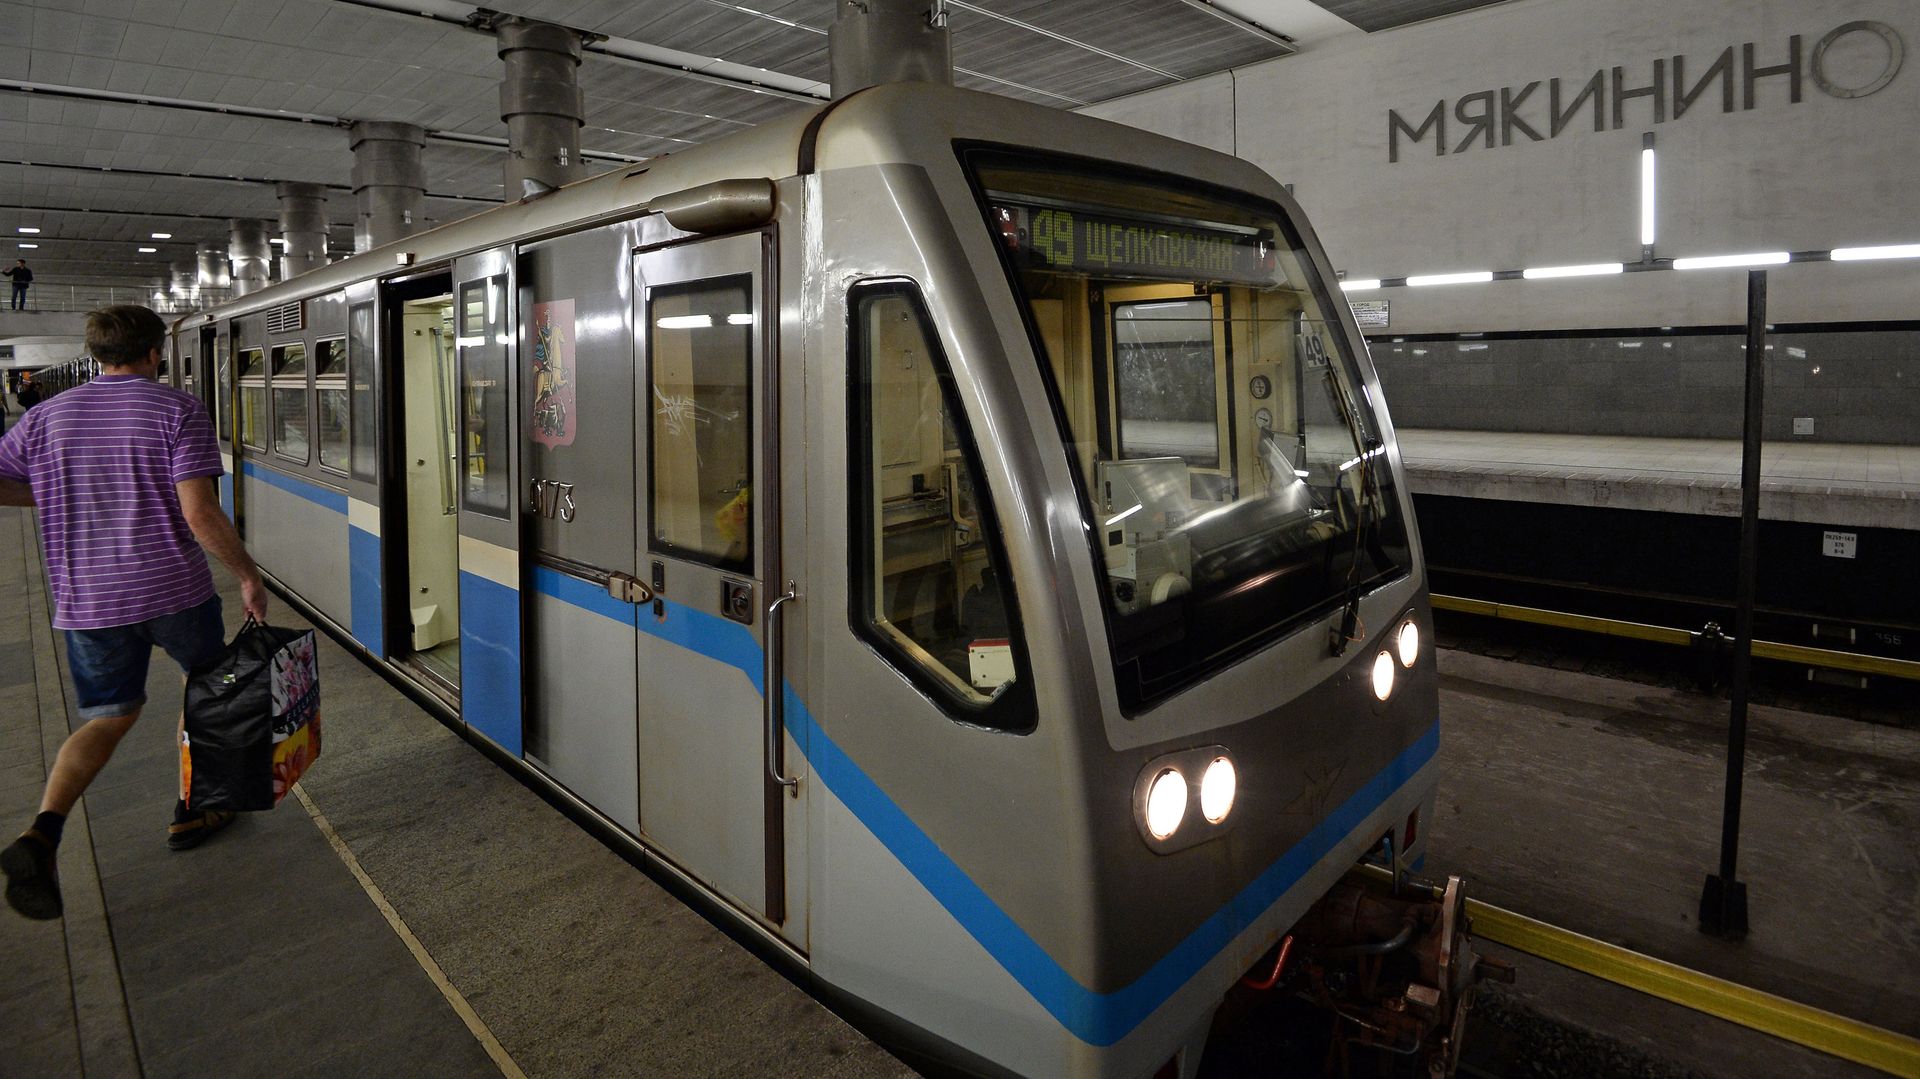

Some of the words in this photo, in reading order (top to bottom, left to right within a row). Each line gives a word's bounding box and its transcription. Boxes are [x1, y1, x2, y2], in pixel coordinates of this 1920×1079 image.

[1388, 20, 1905, 162] МЯКИНИНО
[1032, 209, 1074, 265] 49
[1305, 335, 1325, 366] 49
[529, 477, 576, 523] 0173
